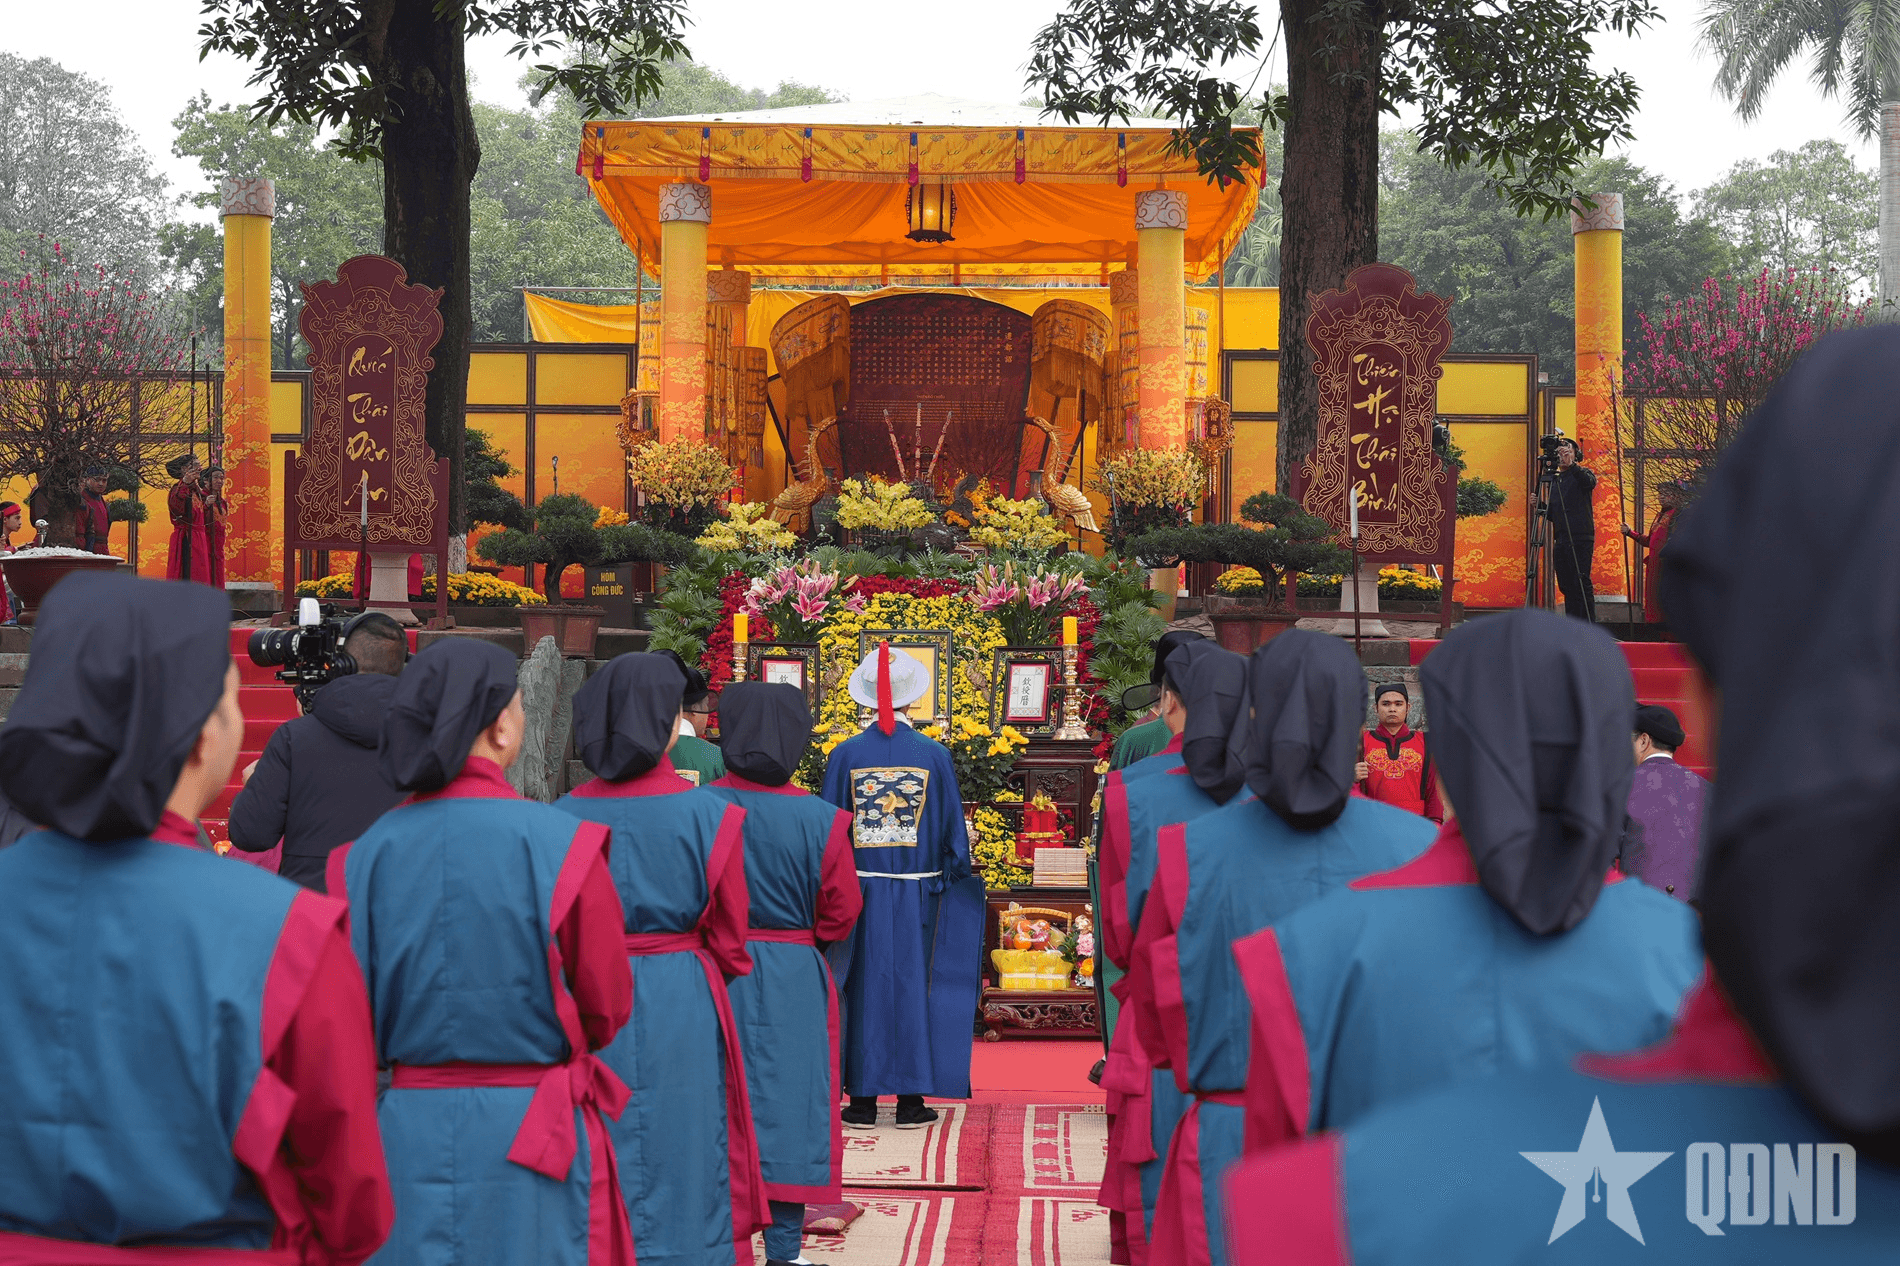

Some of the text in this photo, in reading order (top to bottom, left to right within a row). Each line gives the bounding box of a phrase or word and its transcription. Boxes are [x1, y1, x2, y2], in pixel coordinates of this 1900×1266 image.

[349, 346, 393, 377] Quốc
[1353, 353, 1402, 386] Thiên
[347, 392, 389, 424] Thái
[1353, 384, 1400, 429] Hạ
[1351, 433, 1398, 469] Thái
[344, 469, 389, 506] An
[1349, 472, 1397, 512] Bình
[591, 582, 624, 596] CÔNG ĐỨC
